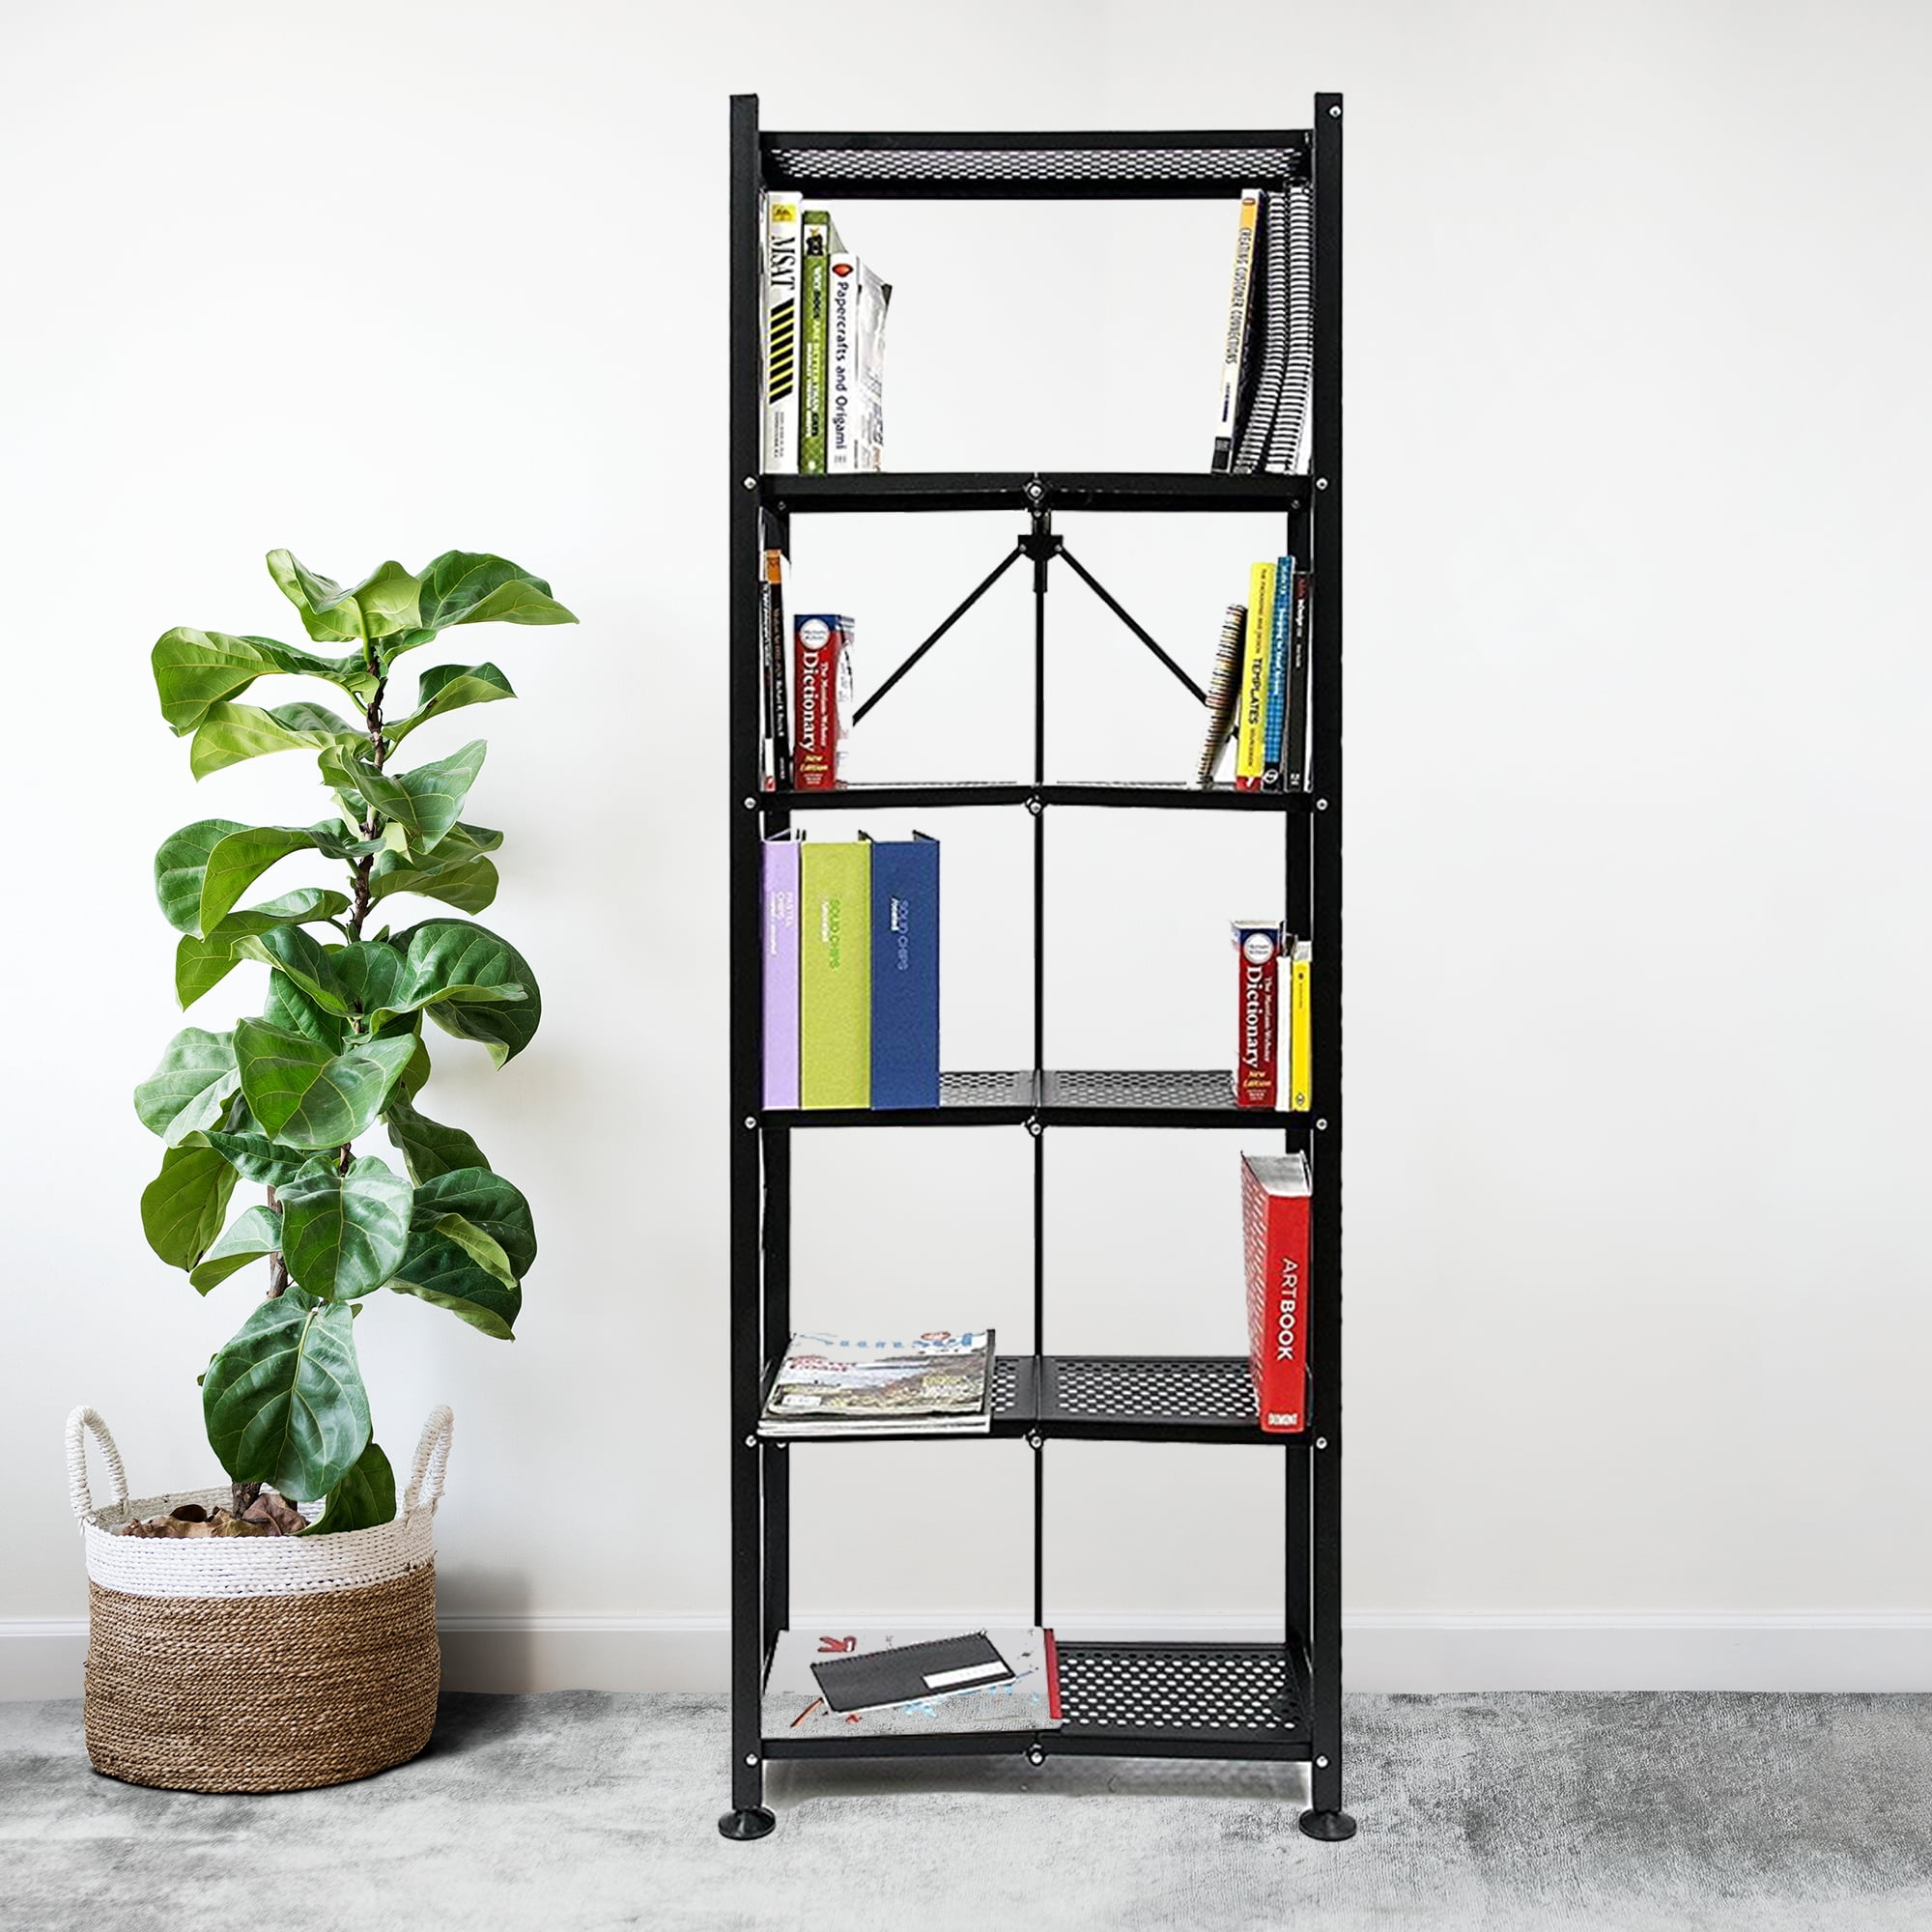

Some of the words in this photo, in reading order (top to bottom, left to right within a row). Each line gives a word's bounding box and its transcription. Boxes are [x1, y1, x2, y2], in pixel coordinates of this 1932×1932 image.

[1236, 227, 1252, 264] CREATING
[1231, 267, 1247, 308] CUSTOMER
[835, 282, 849, 360] Papercrafts
[1226, 310, 1242, 365] CONNECTIONS
[836, 366, 849, 390] and
[833, 395, 848, 449] Origami
[800, 651, 819, 752] Dictionary
[1249, 658, 1263, 724] TEMPLATES
[830, 899, 839, 932] SOLID
[898, 900, 909, 934] SOLID
[830, 936, 839, 970] CHIPS
[897, 936, 908, 970] CHIPS
[1264, 977, 1272, 992] The
[1242, 966, 1263, 1067] Dictionary
